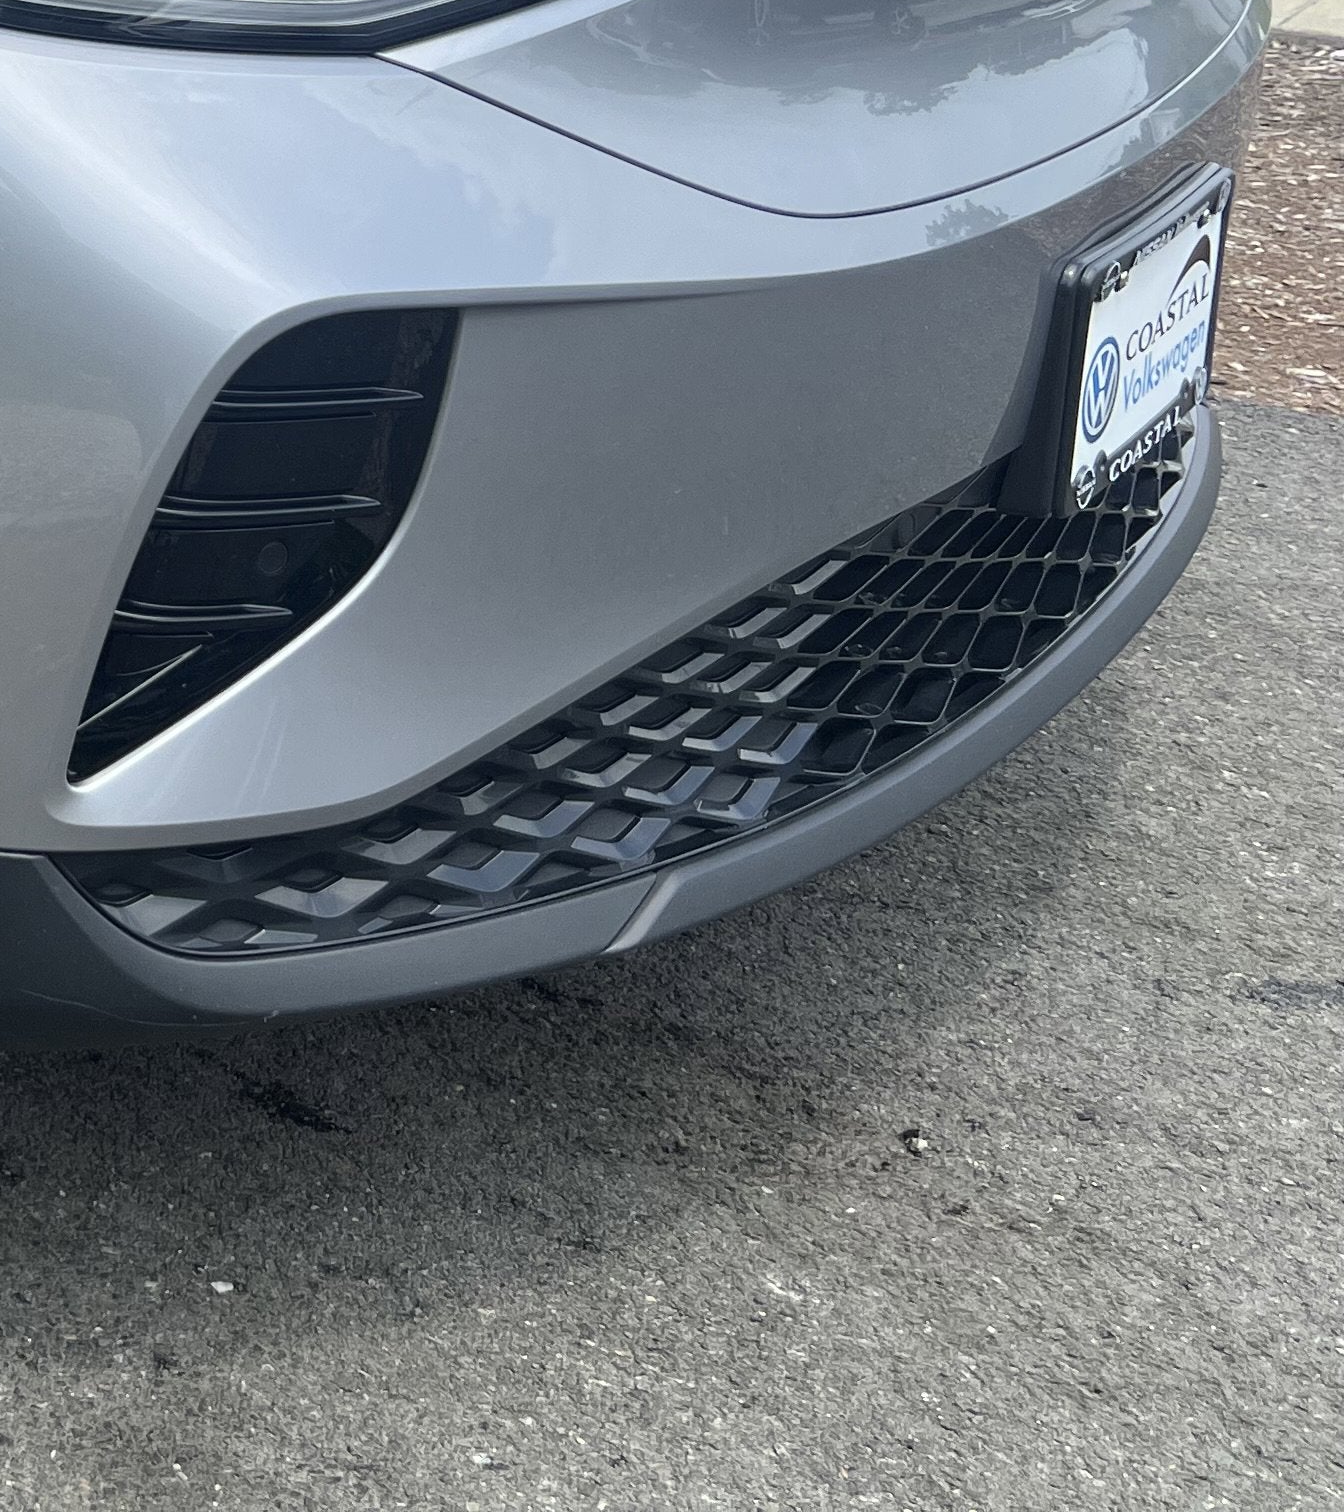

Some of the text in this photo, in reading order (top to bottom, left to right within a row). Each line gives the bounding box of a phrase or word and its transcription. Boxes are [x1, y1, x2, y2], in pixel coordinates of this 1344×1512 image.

[1126, 273, 1209, 361] COASTAL
[1124, 319, 1205, 413] Volkswagen
[1109, 406, 1180, 481] COASTAL
